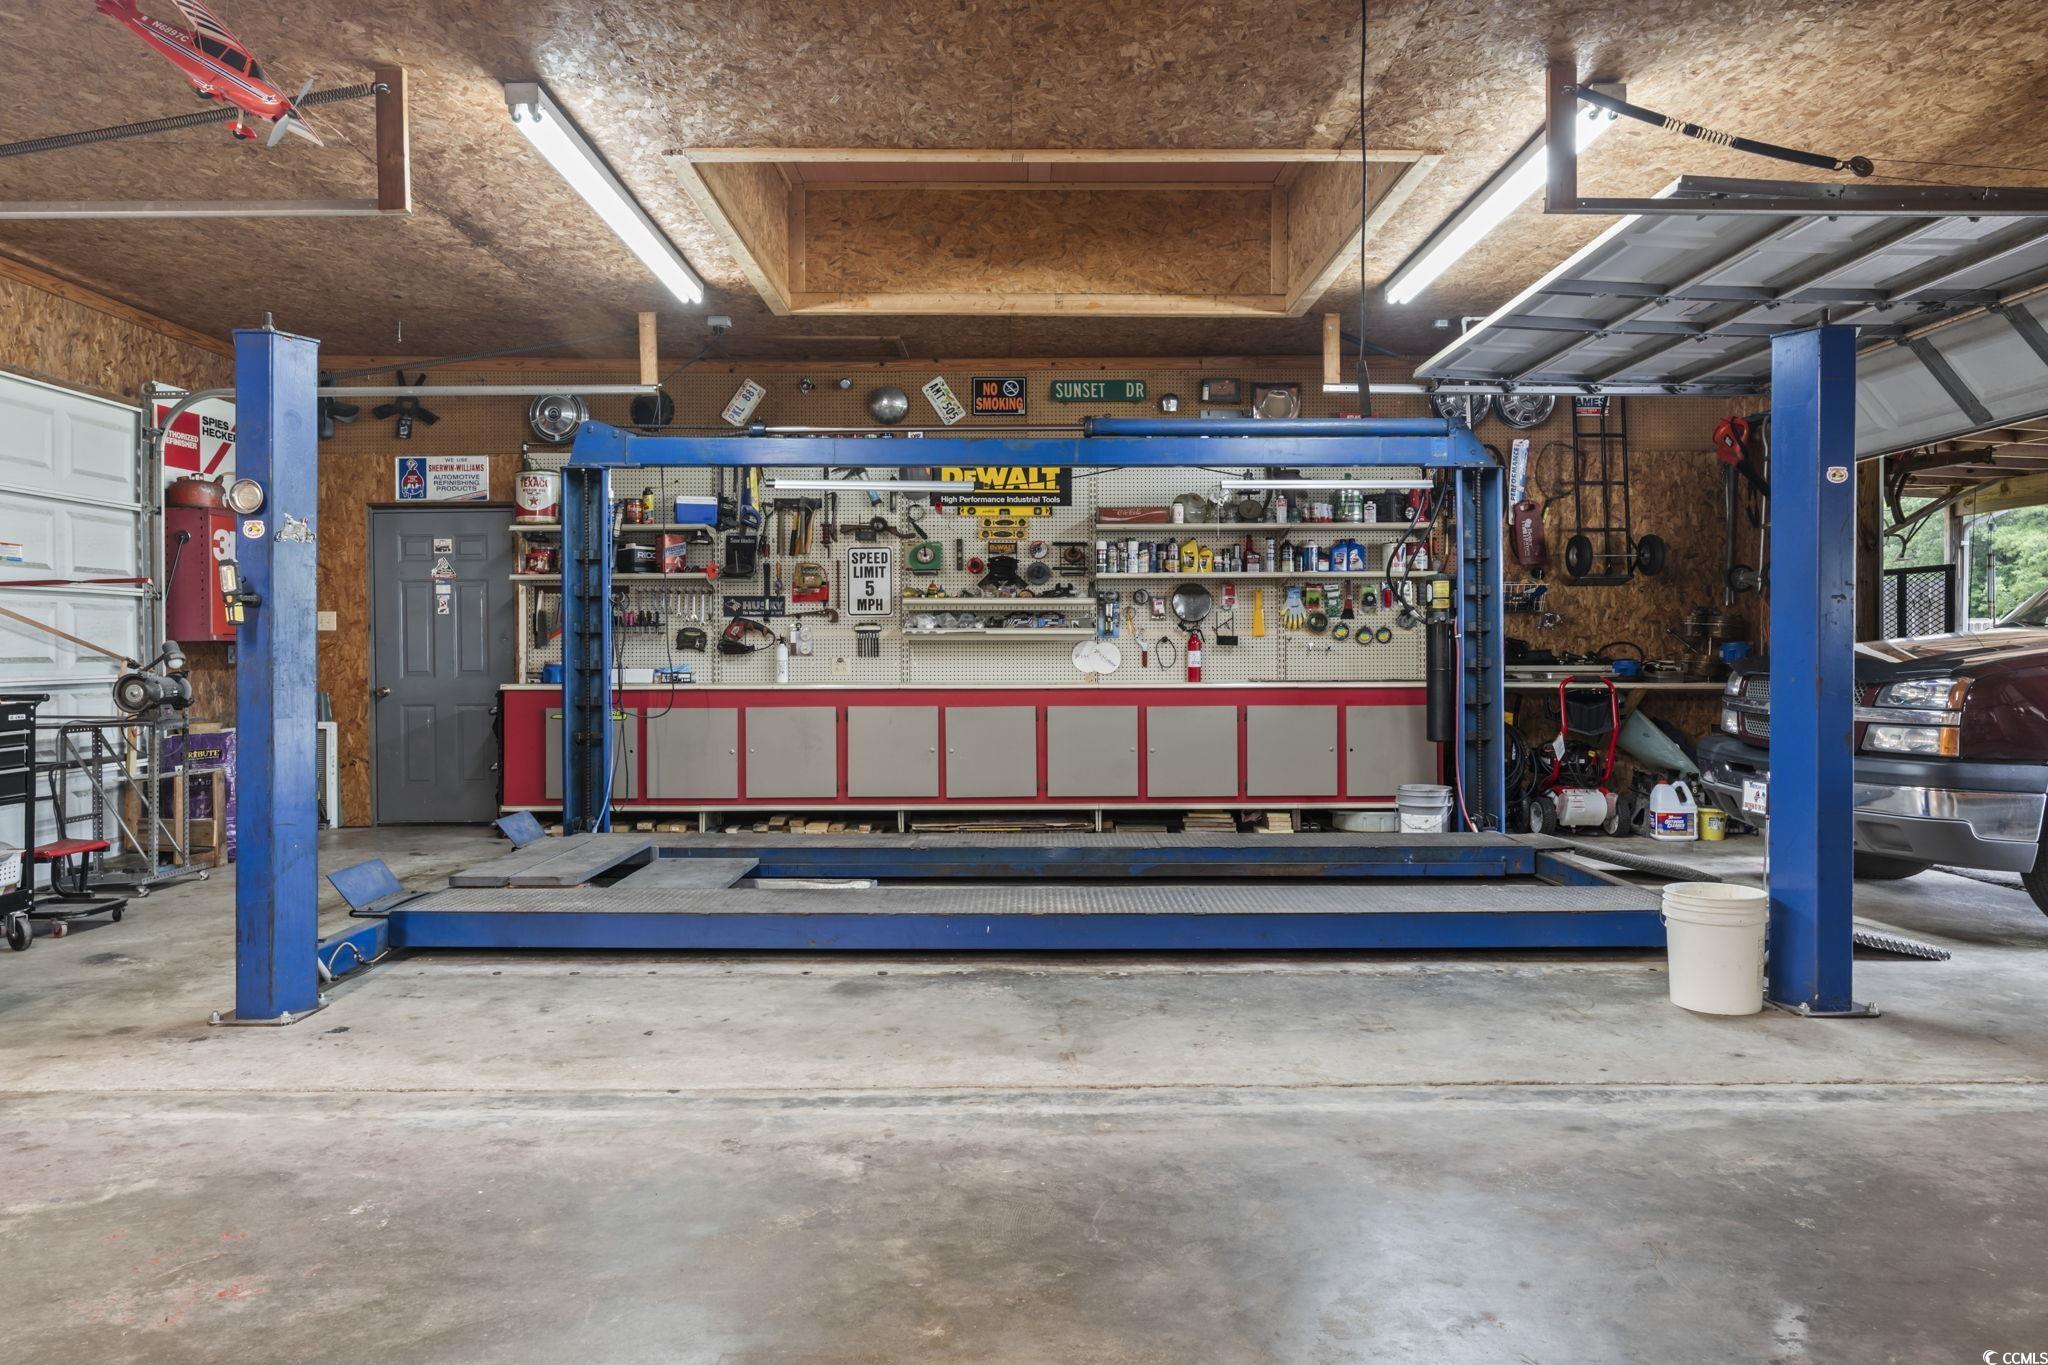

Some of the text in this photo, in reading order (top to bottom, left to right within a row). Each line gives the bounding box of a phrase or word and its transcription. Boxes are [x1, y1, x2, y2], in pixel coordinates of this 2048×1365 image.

[742, 385, 758, 401] 881
[983, 382, 998, 396] NO
[1055, 382, 1144, 398] SUNSET DR
[929, 383, 959, 420] AMT 505
[976, 397, 1024, 410] SMOKING
[202, 416, 229, 431] SPIES
[168, 430, 199, 443] THORIZED
[166, 437, 198, 450] EFINISHER
[428, 464, 485, 472] SHERWIN-WILLIAMS
[851, 552, 888, 564] SPEED
[853, 566, 886, 578] LIMIT
[865, 580, 875, 596] 5
[857, 598, 883, 611] MPH
[188, 749, 220, 758] RIBUTE
